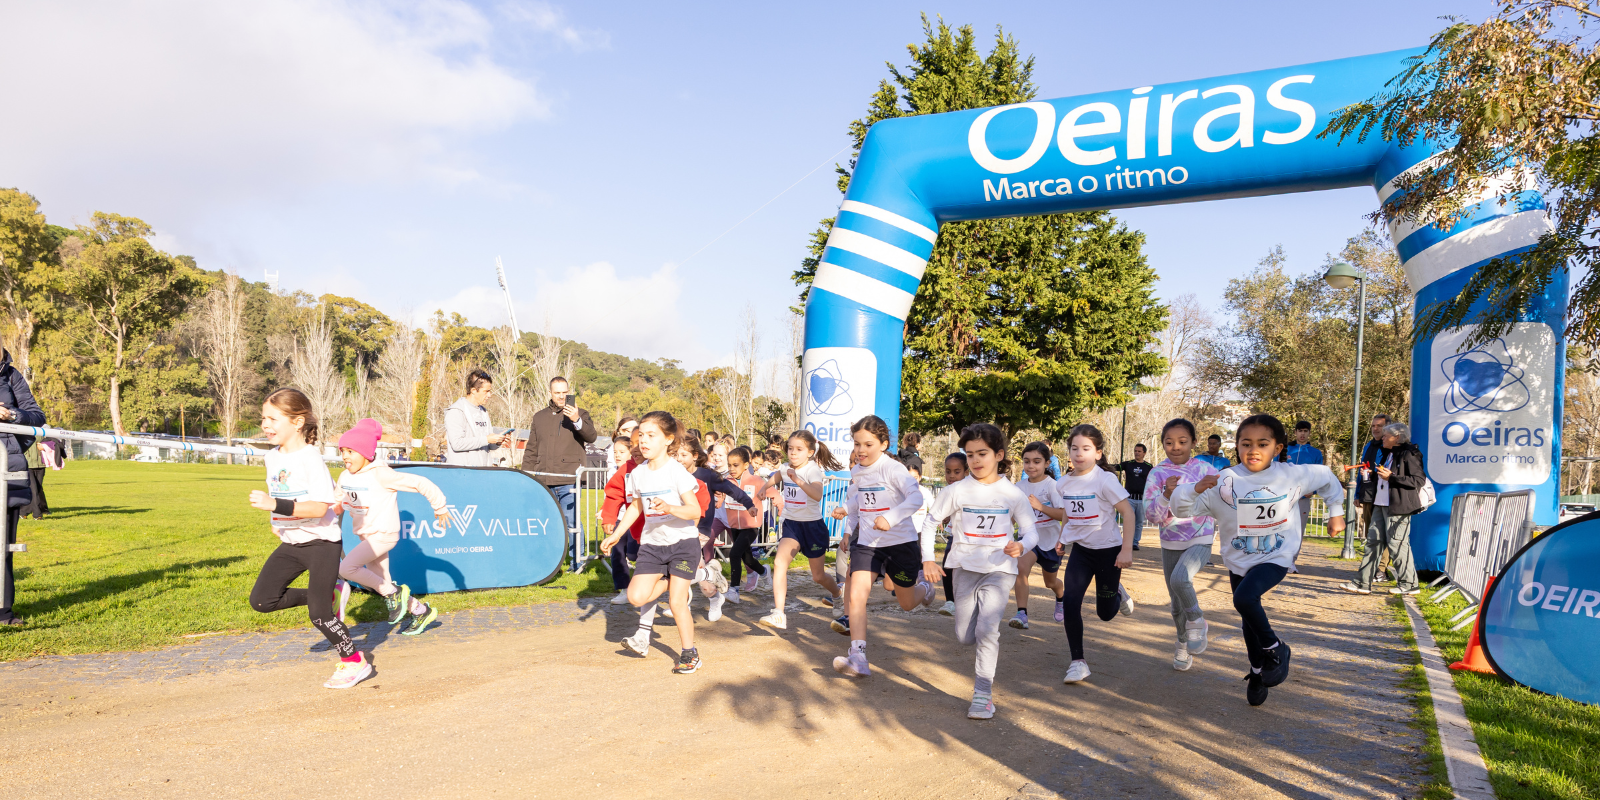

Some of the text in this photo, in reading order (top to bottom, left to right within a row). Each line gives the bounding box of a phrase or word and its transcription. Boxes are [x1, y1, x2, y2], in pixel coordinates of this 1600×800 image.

[968, 75, 1316, 175] Oeiras
[983, 165, 1189, 202] Marca o ritmo
[804, 422, 853, 442] Oeira
[1442, 420, 1544, 447] Oeiras
[833, 446, 850, 455] ritm
[1446, 452, 1535, 464] Marca o ritmo
[786, 487, 797, 498] 30
[864, 492, 877, 505] 33
[1071, 500, 1085, 513] 28
[1256, 503, 1276, 520] 26
[478, 518, 550, 537] VALLEY
[976, 515, 997, 530] 27
[435, 545, 494, 555] MUNICÍPIO OEIRAS
[1518, 581, 1600, 619] OEIR
